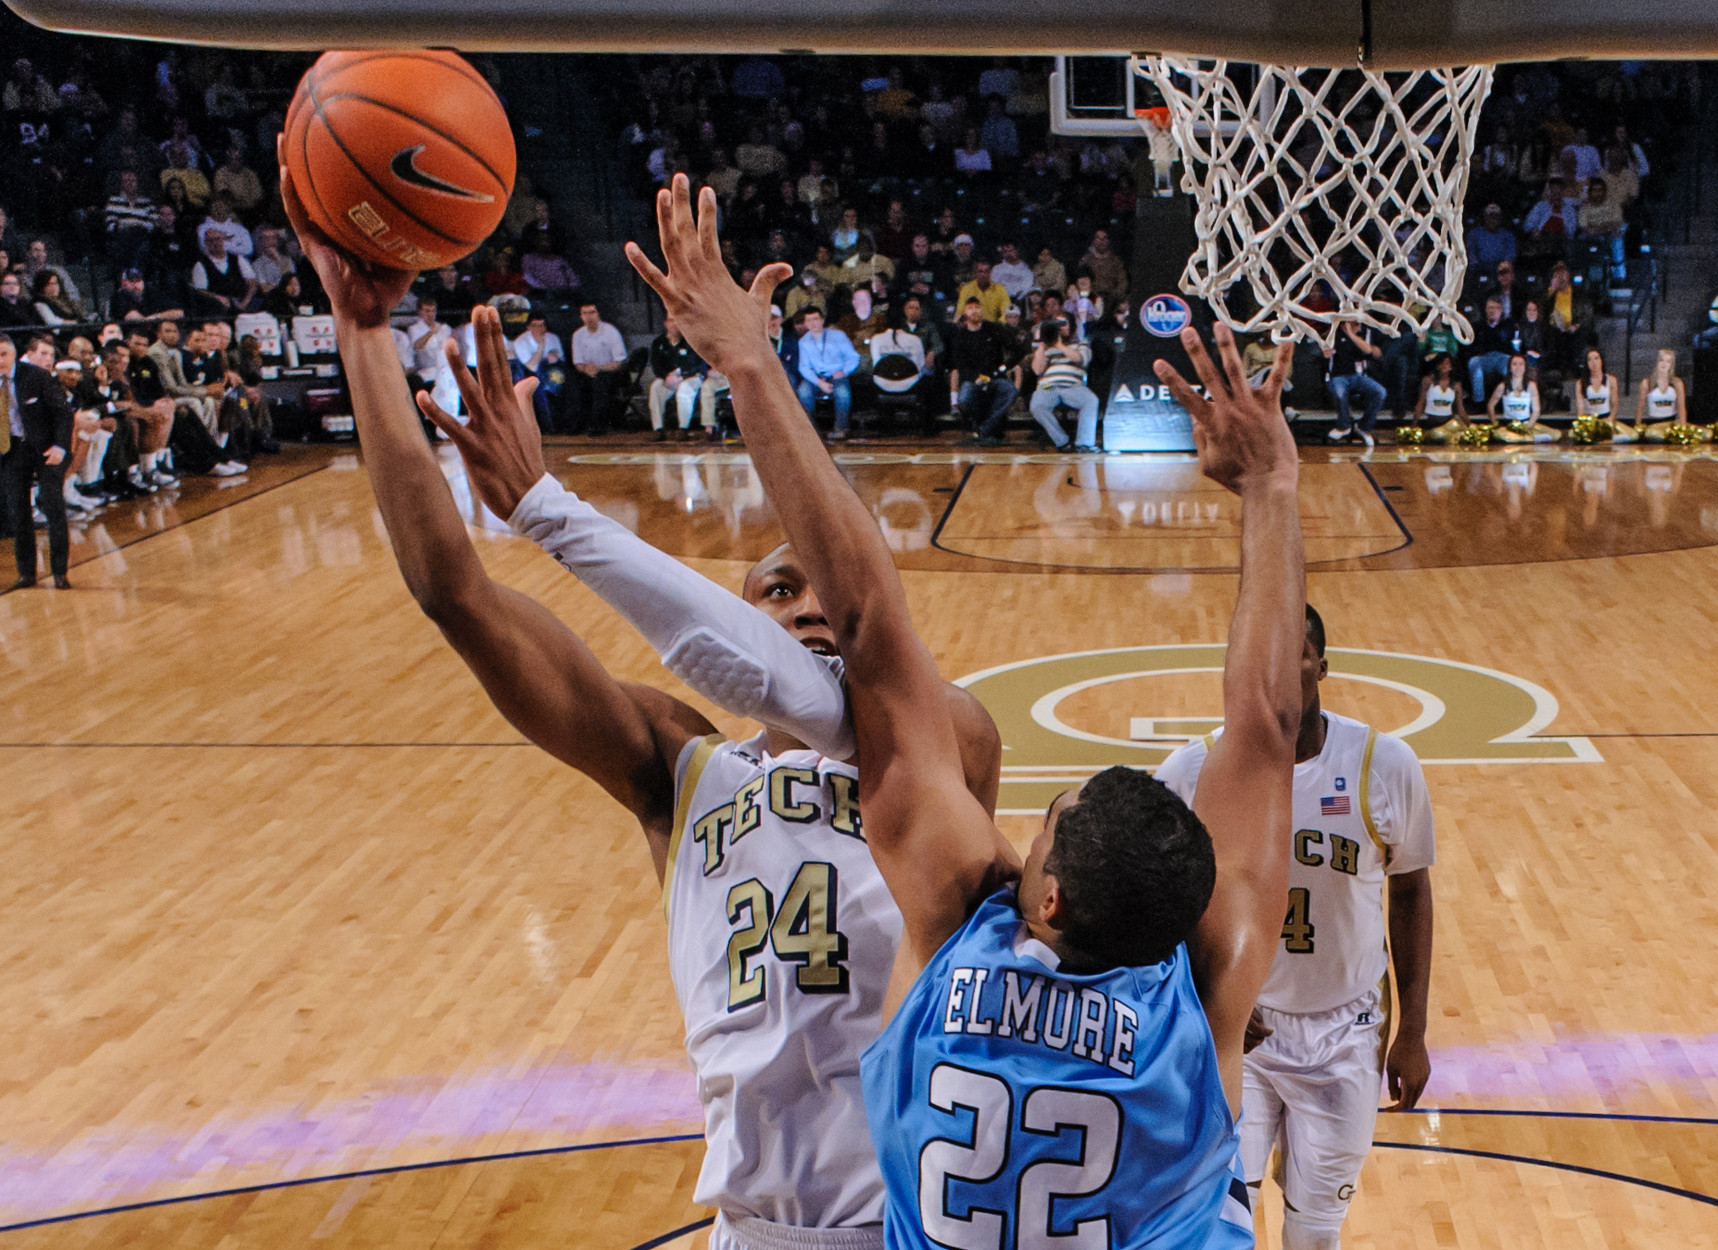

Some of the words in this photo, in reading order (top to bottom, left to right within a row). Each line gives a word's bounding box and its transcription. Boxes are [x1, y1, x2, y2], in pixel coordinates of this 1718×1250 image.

[1294, 828, 1360, 876] CH
[726, 861, 850, 1013] 24
[944, 966, 1139, 1079] ELMORE
